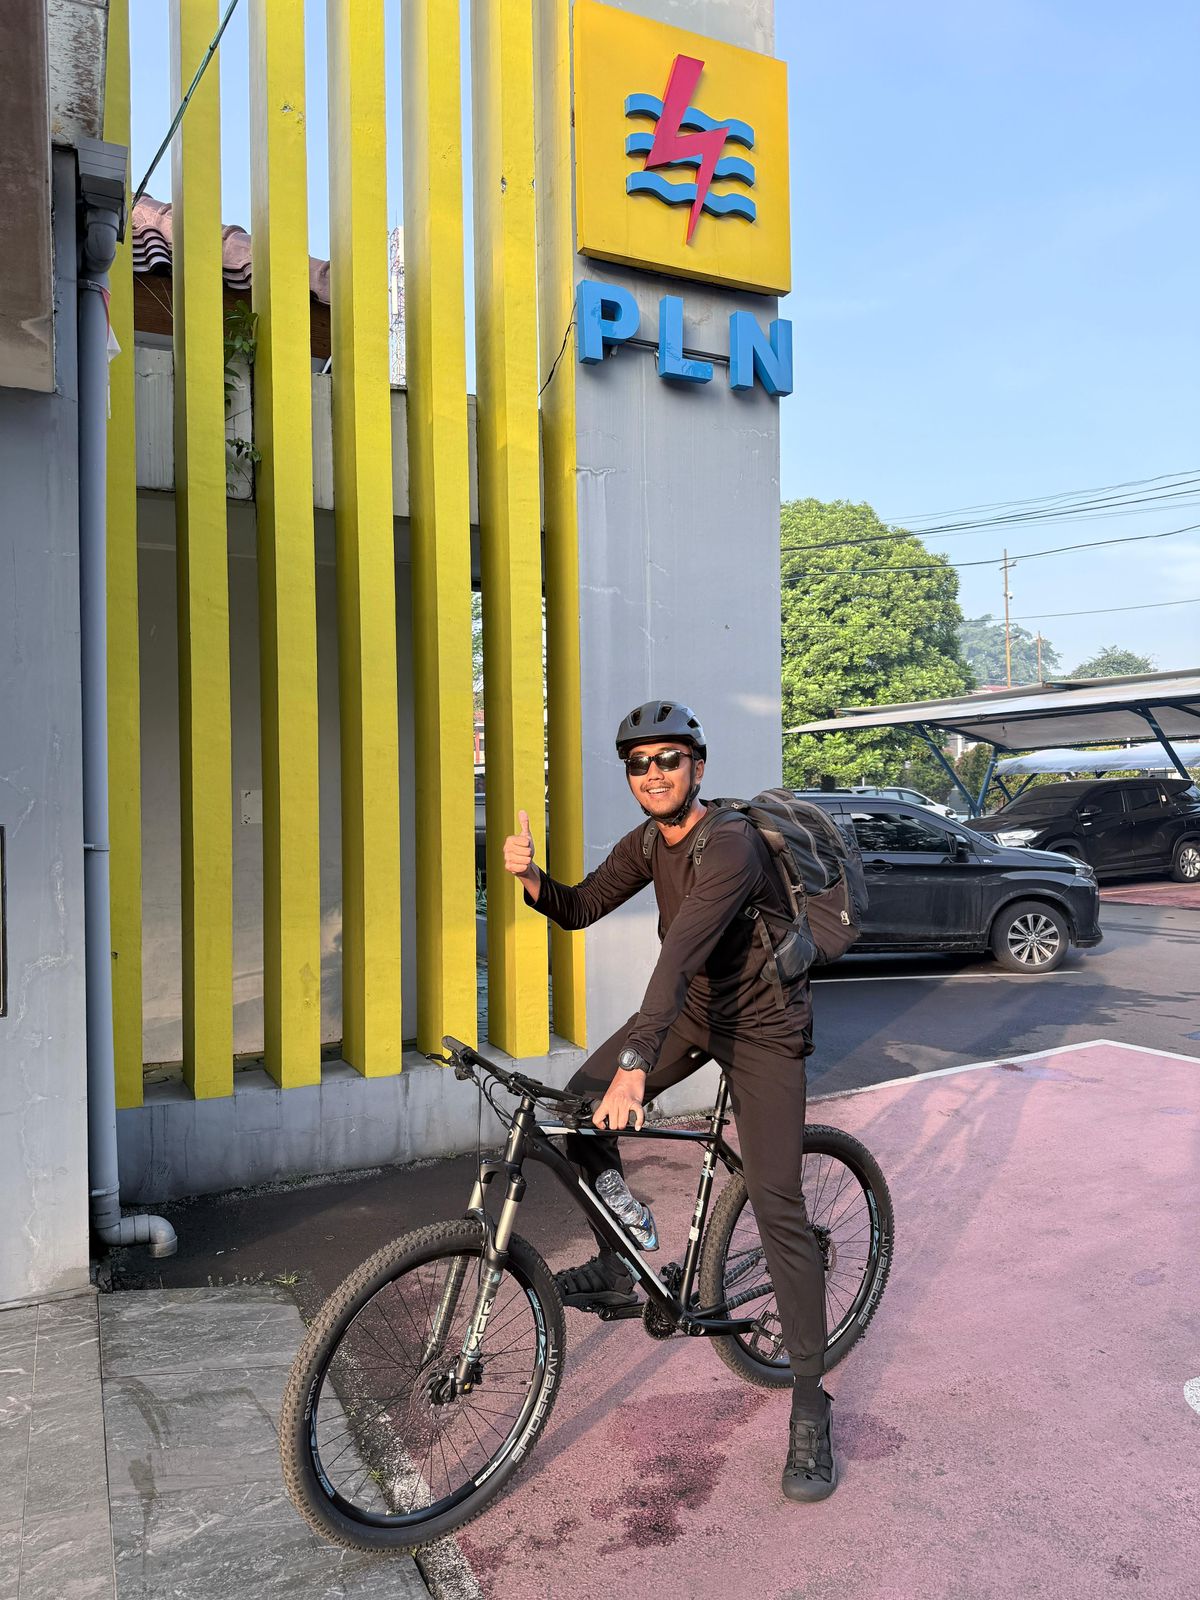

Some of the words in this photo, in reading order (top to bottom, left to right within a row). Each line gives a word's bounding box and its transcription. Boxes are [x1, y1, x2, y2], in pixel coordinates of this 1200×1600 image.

[577, 280, 793, 396] PLN
[858, 1235, 890, 1327] SPIDERBAIT
[304, 1374, 319, 1420] ENTITY
[511, 1348, 559, 1463] SPIDERBAIT
